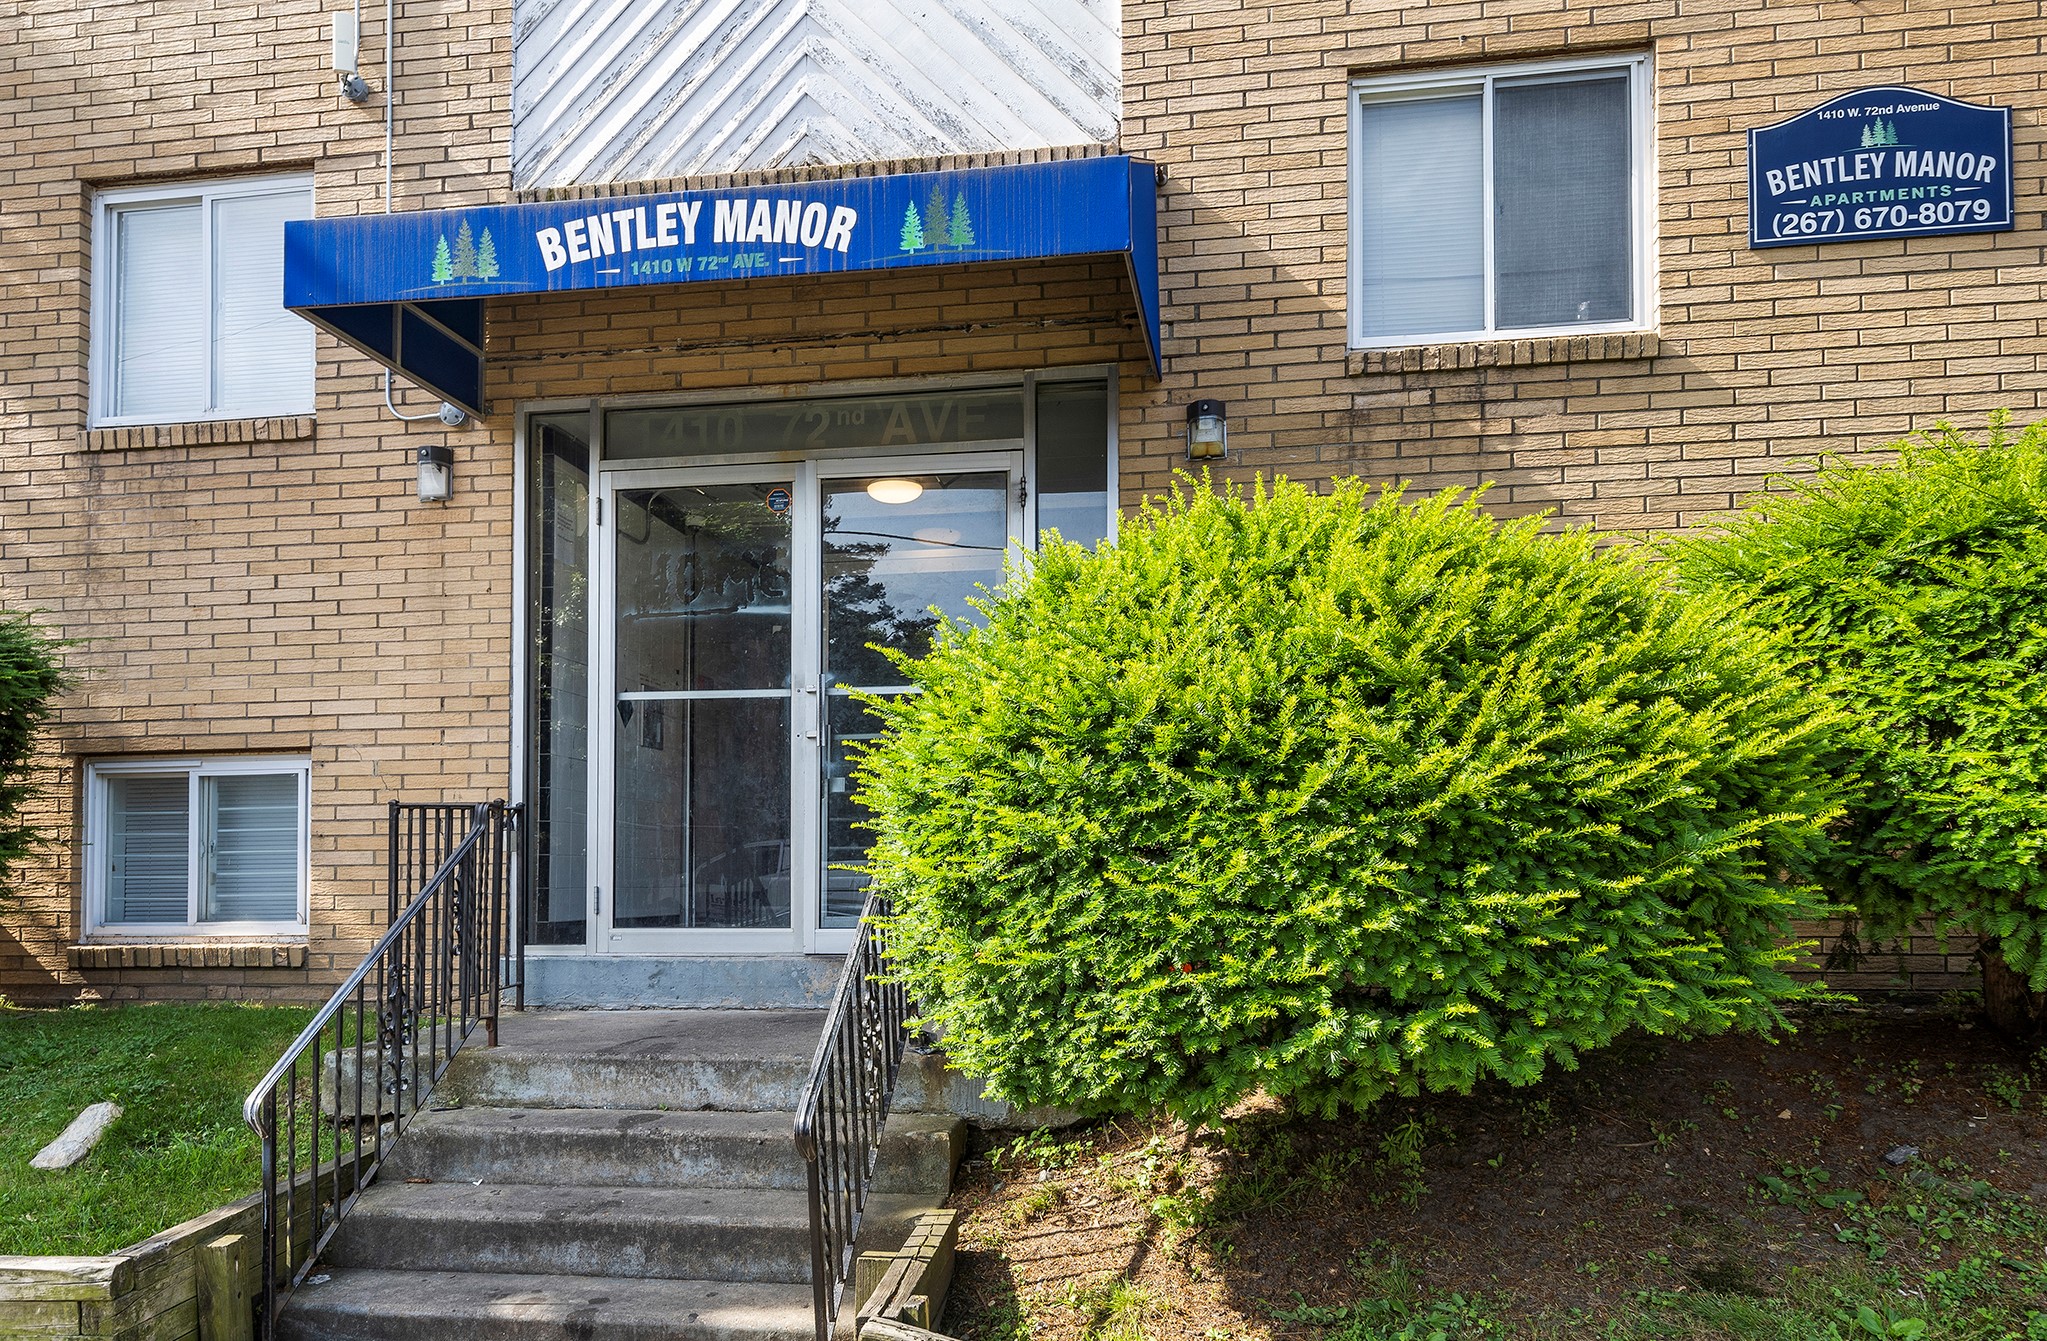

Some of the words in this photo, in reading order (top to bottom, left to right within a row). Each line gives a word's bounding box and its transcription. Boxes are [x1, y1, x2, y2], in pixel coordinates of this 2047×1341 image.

[1817, 108, 1845, 121] 1410
[1846, 107, 1862, 118] W.
[1864, 104, 1893, 116] 72nd
[1896, 102, 1940, 114] Avenue
[1765, 151, 1886, 196] BENTLEY
[1894, 150, 1997, 183] MANOR
[1809, 184, 1952, 207] APARTMENTS
[535, 200, 703, 273] BENTLEY
[713, 199, 858, 253] MANOR
[1772, 208, 1845, 238] (267)
[1854, 198, 1991, 230] 670-8079
[630, 258, 673, 276] 1410
[675, 257, 692, 273] W
[697, 255, 729, 271] 72nd
[732, 252, 770, 269] AVE.
[774, 404, 866, 448] 72nd
[880, 398, 989, 446] AVE
